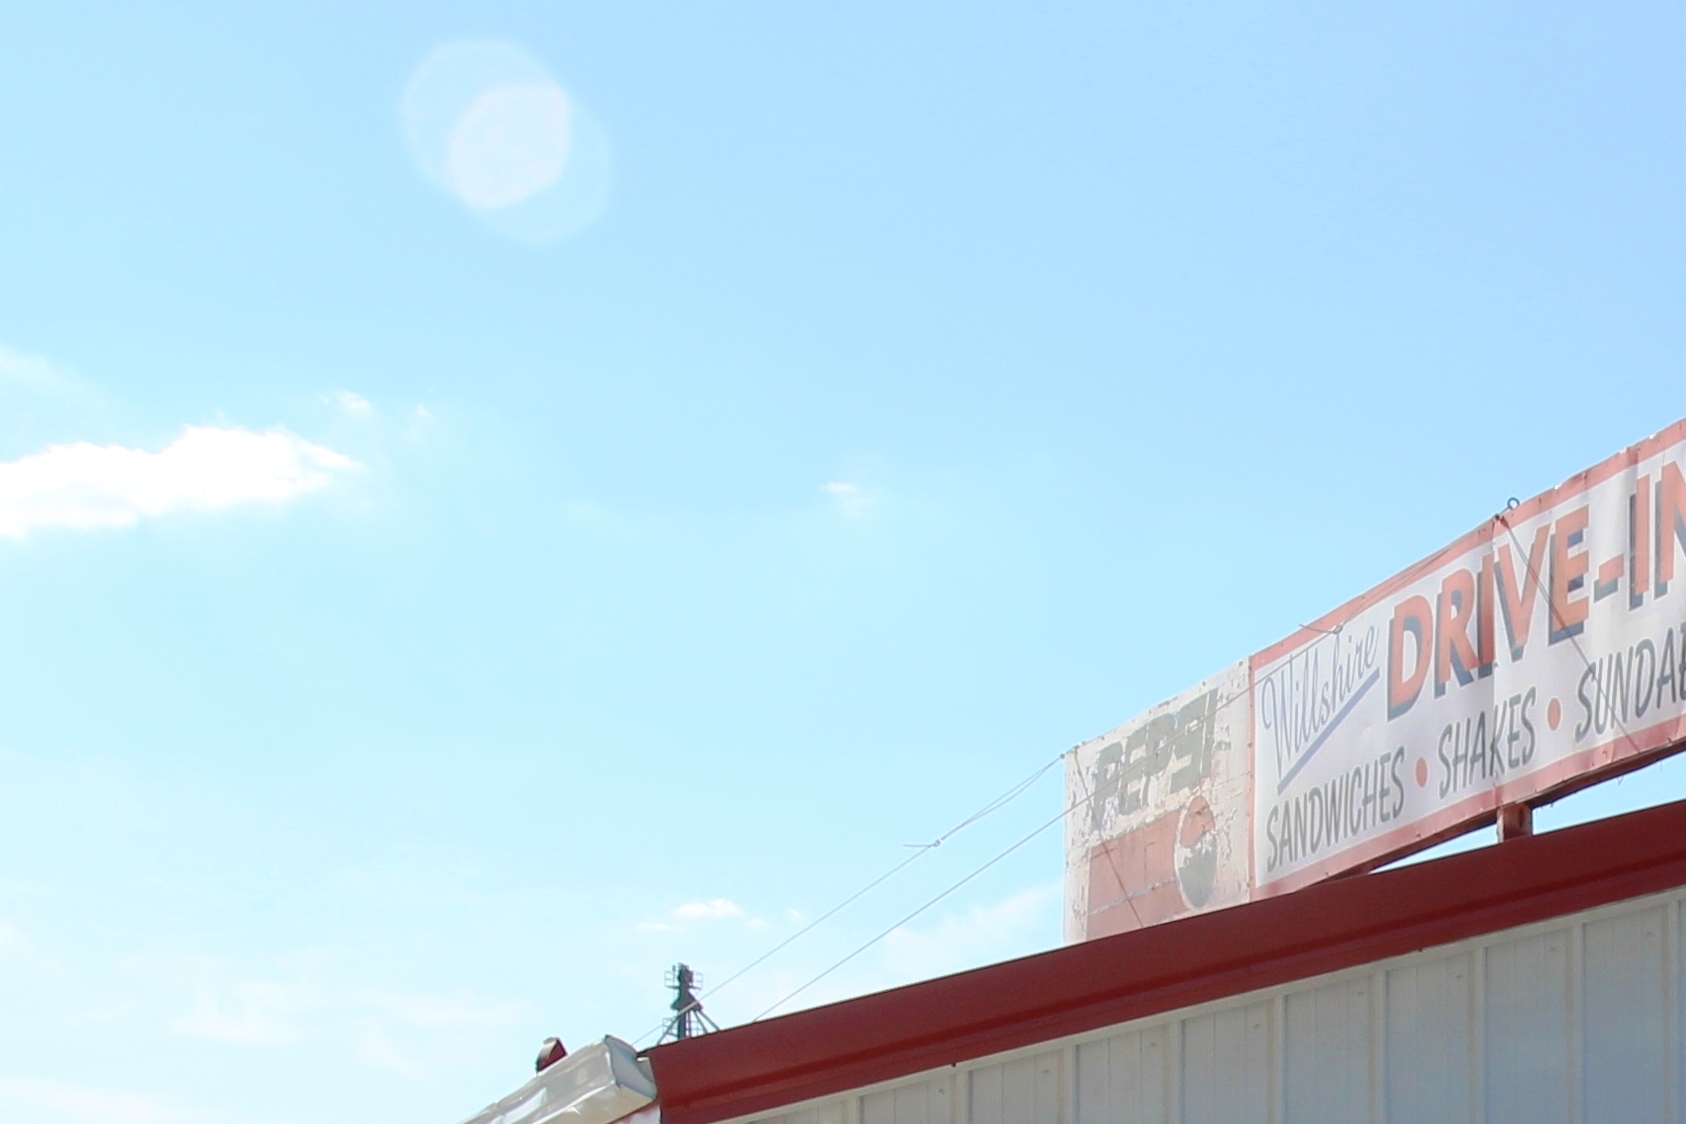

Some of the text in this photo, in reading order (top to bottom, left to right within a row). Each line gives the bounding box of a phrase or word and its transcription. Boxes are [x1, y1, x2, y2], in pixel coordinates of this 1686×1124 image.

[1091, 686, 1219, 832] PEPSI
[1261, 624, 1379, 781] Willshire
[1266, 745, 1405, 873] SANDWICHES
[1437, 685, 1537, 799] SHAKES
